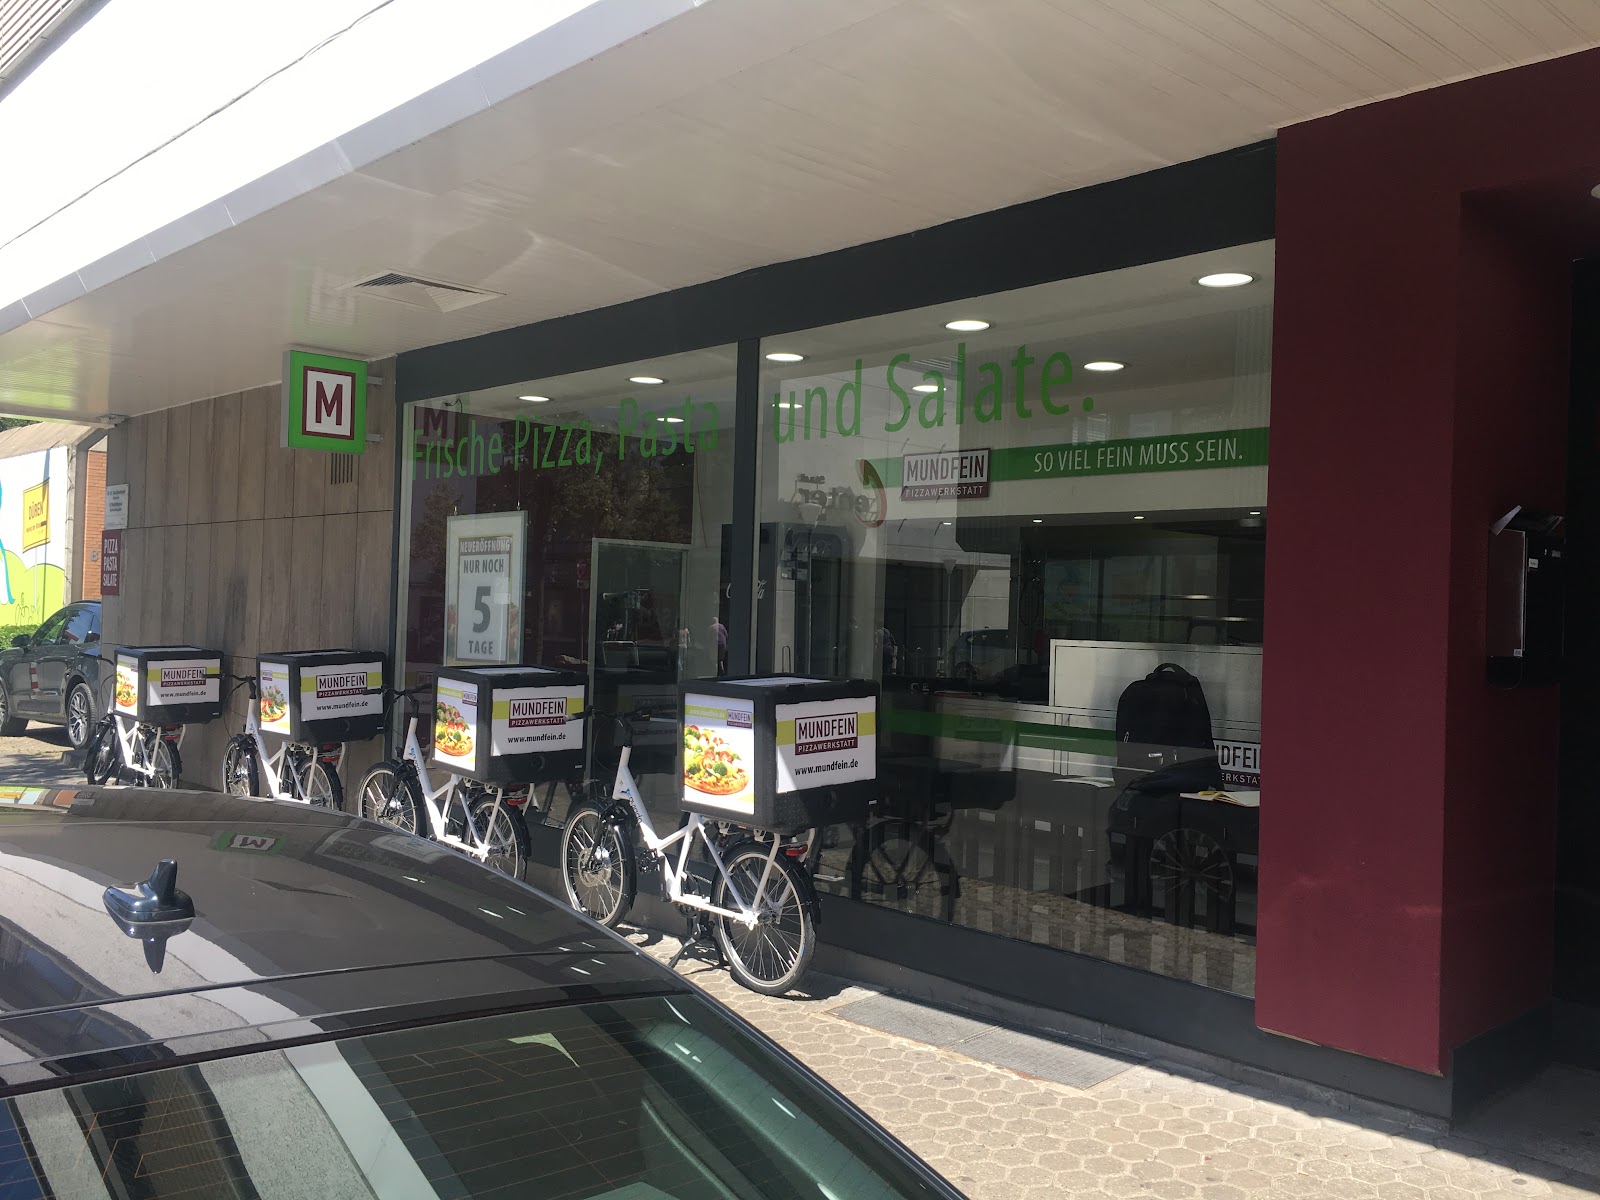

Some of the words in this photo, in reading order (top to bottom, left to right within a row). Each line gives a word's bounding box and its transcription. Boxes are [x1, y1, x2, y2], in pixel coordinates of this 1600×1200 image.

[315, 380, 343, 426] M
[412, 419, 501, 481] Frische
[513, 414, 604, 475] Pizza,
[618, 393, 720, 461] Pasta
[772, 358, 863, 445] und
[884, 342, 1094, 433] Salate.
[1033, 451, 1055, 474] SO
[1057, 447, 1092, 471] VIEL
[1097, 444, 1134, 469] FEIN
[1139, 441, 1189, 466] MUSS
[1194, 437, 1244, 462] SEIN.
[906, 455, 984, 482] MUNDFEIN
[103, 538, 118, 554] PIZZA
[460, 537, 511, 553] NEUERÖFFNUNG
[103, 556, 117, 571] PASTA
[463, 559, 480, 574] NUR
[482, 558, 504, 573] NOCH
[102, 573, 117, 587] SALATE
[472, 585, 491, 634] 5
[468, 640, 493, 655] TAGE
[163, 669, 205, 680] MUNDFEIN
[319, 675, 365, 689] MUNDFEIN
[316, 700, 368, 711] www.mundfein.de
[512, 700, 564, 717] MUNDFEIN
[511, 717, 564, 727] PIZZAWERKSTATT
[728, 711, 752, 723] MUNDFEIN
[798, 716, 855, 741] MUNDFEIN
[507, 732, 566, 744] www.mundfein.de
[798, 738, 855, 753] PIZZAWERKSTATT
[794, 758, 859, 776] www.mundfein.de
